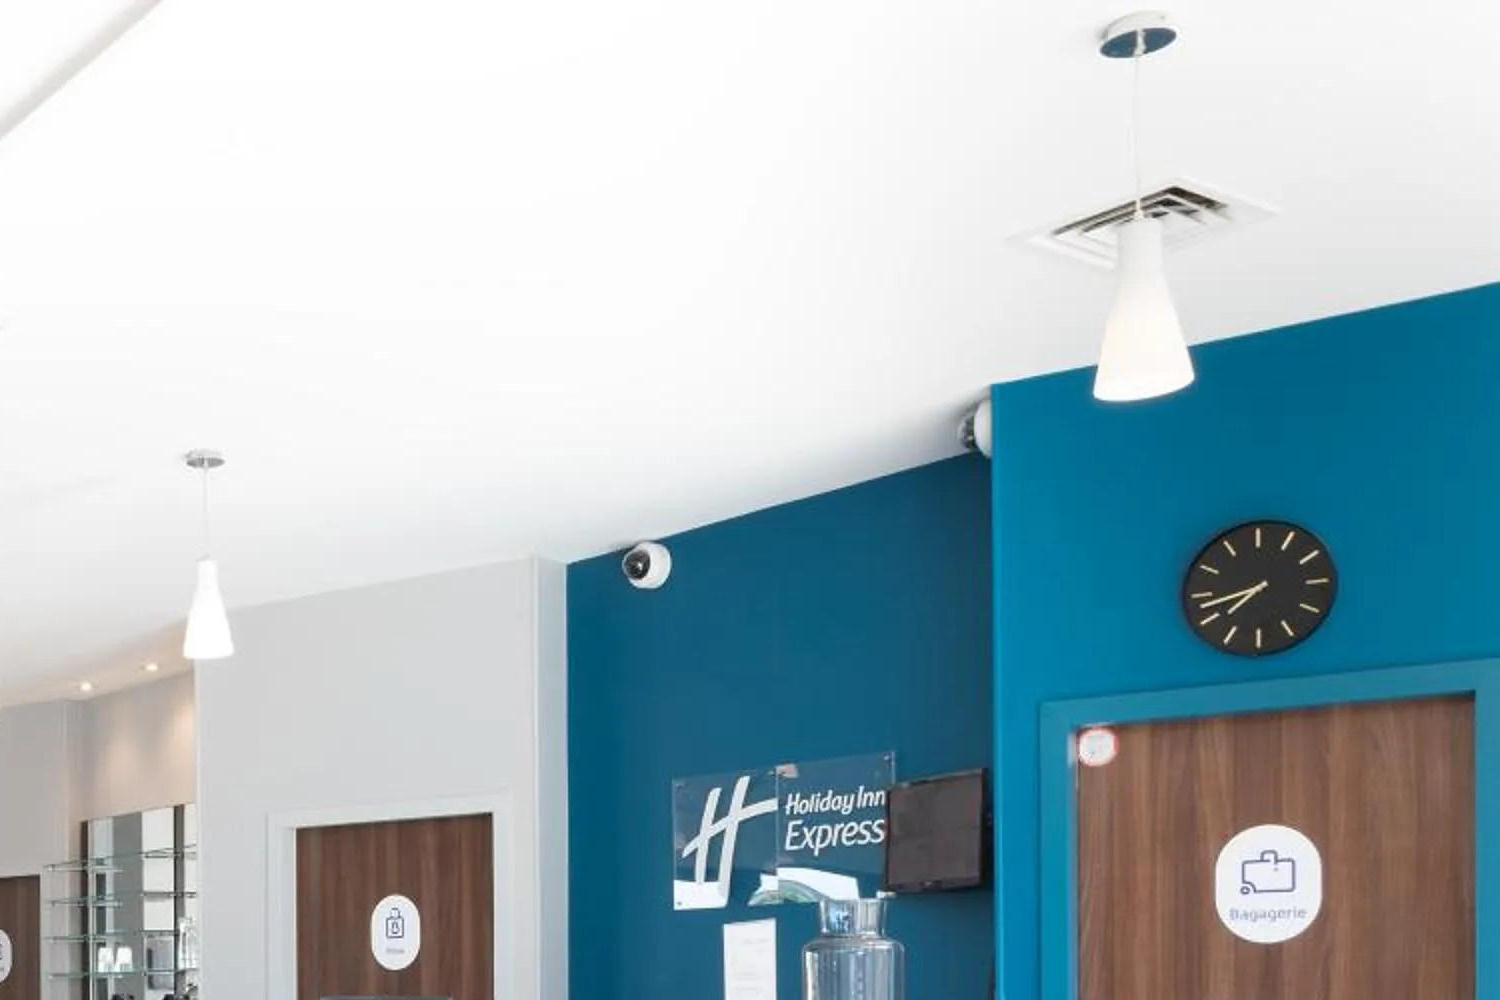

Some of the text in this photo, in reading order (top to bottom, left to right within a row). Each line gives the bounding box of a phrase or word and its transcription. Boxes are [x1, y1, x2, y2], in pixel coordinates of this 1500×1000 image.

[785, 785, 885, 816] Holiday Inn
[785, 818, 886, 857] Express
[1229, 906, 1308, 922] Bagagerie
